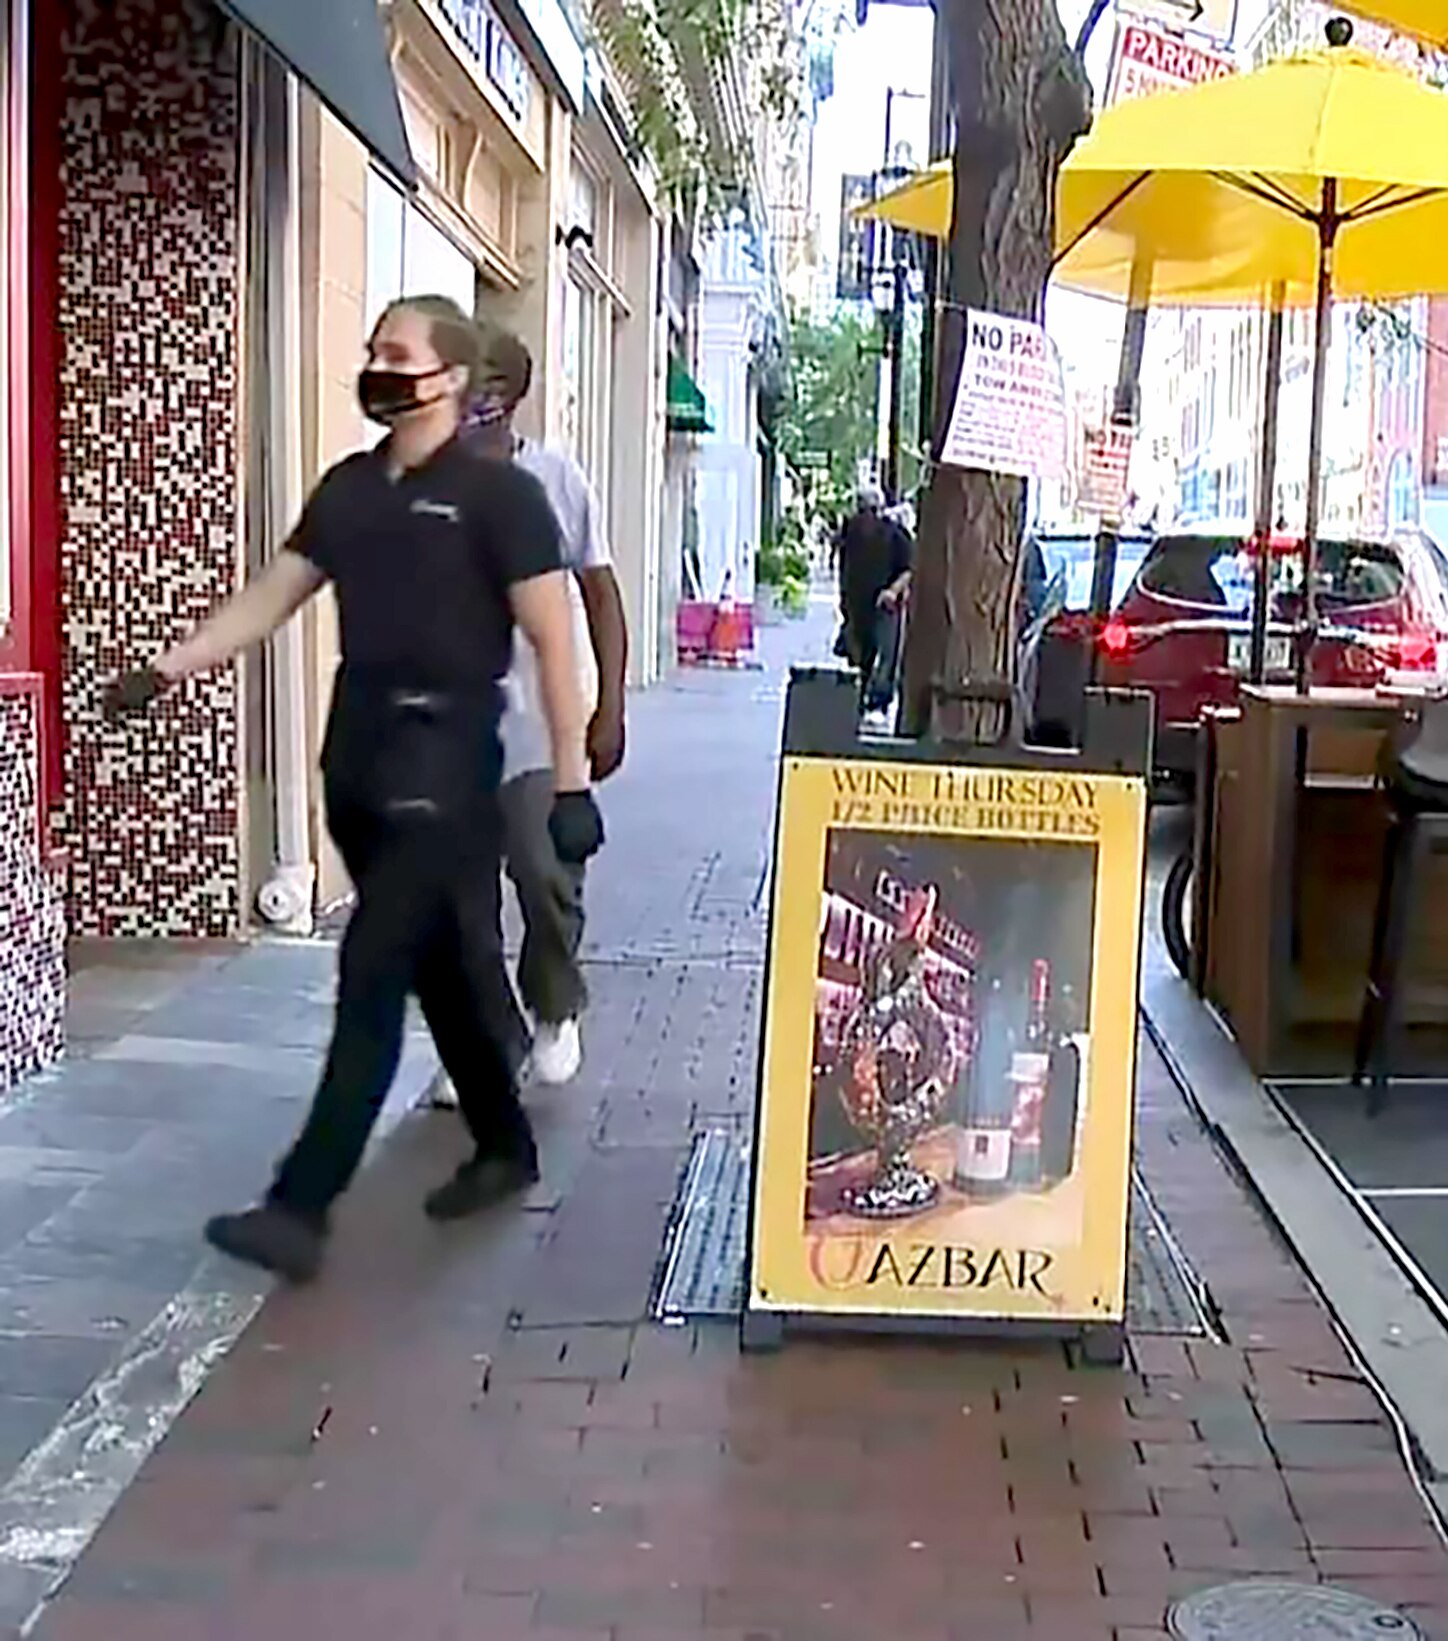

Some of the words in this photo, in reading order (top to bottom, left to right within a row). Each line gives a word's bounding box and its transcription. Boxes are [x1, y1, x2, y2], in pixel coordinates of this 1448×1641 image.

[972, 321, 1003, 352] NO
[832, 768, 908, 797] WINE
[932, 773, 1099, 809] THURSDAY
[832, 801, 872, 823] 1/2
[882, 802, 968, 828] PRICE
[977, 807, 1100, 836] BOTTLES
